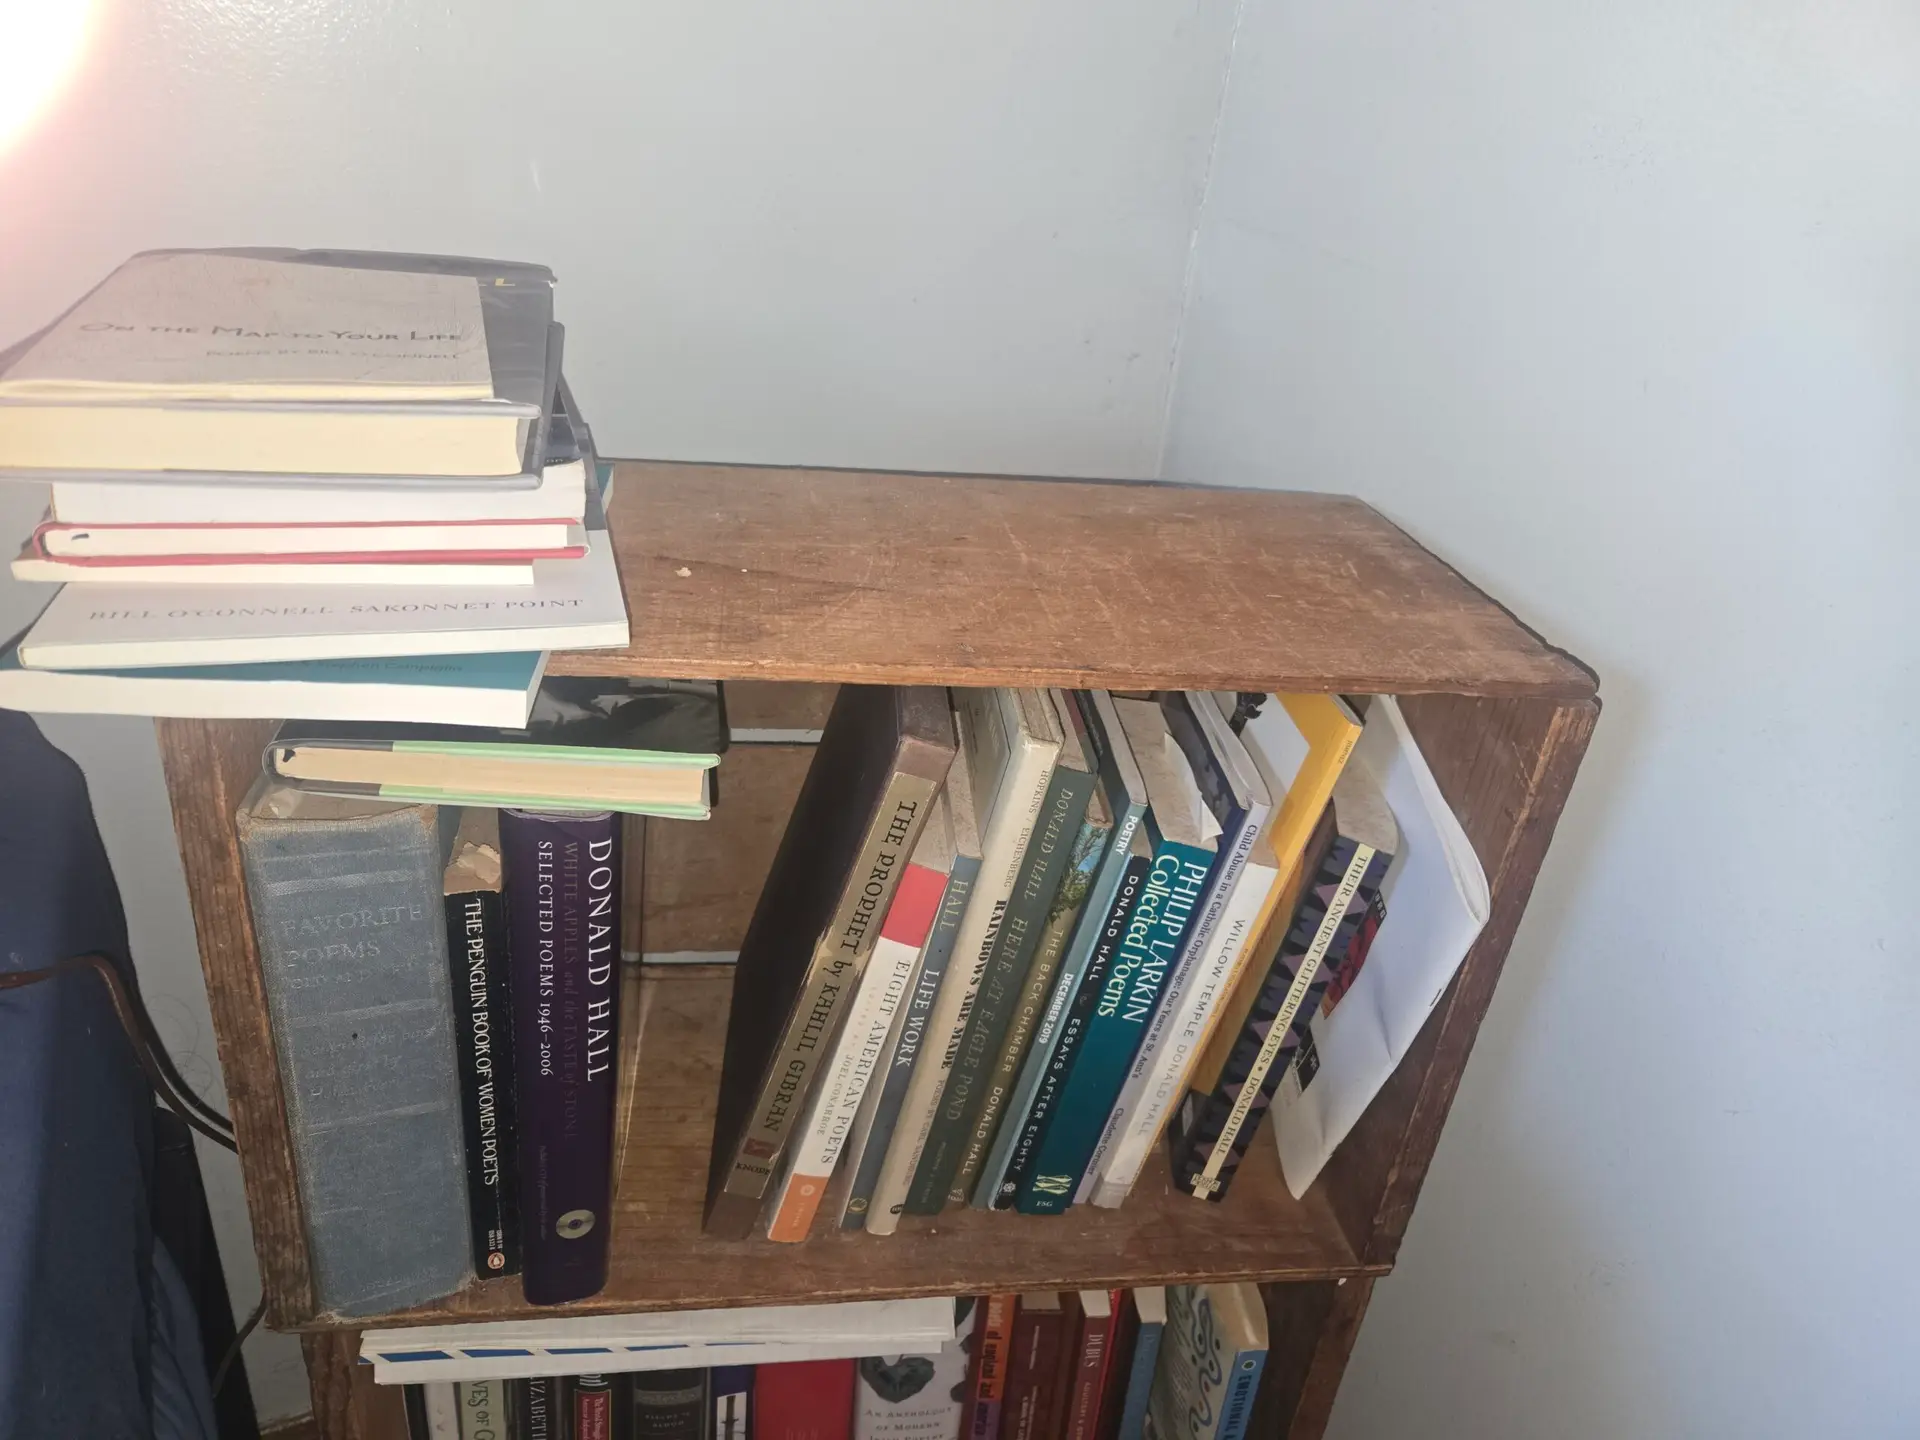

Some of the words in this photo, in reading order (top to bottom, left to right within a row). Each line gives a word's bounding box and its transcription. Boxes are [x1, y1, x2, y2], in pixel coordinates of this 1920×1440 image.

[329, 330, 399, 340] YOUR
[90, 609, 157, 621] BILL
[167, 605, 335, 619] O'CONNELL
[350, 601, 496, 614] SAKONNET
[505, 598, 585, 609] POINT
[1028, 769, 1049, 814] HOPKINS
[881, 800, 918, 847] THE
[1044, 787, 1074, 854] DONALD
[1116, 814, 1140, 856] POETRY
[1238, 823, 1259, 852] Child
[564, 842, 579, 901] WHITE
[1003, 827, 1033, 889] EICHENBERG
[1024, 859, 1049, 901] HALL
[1223, 851, 1244, 881] Abuse
[1339, 854, 1369, 897] THEIR
[538, 840, 554, 933] SELECTED
[840, 850, 897, 955] PROPHET
[939, 878, 969, 932] HALL
[1106, 875, 1140, 938] DONALD
[1124, 854, 1181, 951] Collected
[1160, 861, 1209, 937] PHILIP
[1221, 883, 1232, 893] in
[280, 904, 423, 938] FAVORITE
[466, 898, 484, 936] THE
[563, 904, 579, 965] APPLES
[588, 836, 613, 986] DONALD
[1200, 899, 1222, 938] Catholic
[1311, 899, 1347, 958] ANCIENT
[284, 940, 381, 968] POEMS
[970, 899, 1008, 986] RAINBOWS
[997, 914, 1030, 974] HERE
[1044, 927, 1064, 958] THE
[1088, 944, 1111, 981] HALL
[1172, 937, 1205, 989] Orphanage:
[1207, 918, 1246, 979] WILLOW
[467, 937, 489, 1009] PENGUIN
[539, 939, 554, 996] POEMS
[564, 971, 579, 996] and
[822, 959, 853, 979] by
[878, 959, 911, 1017] EIGHT
[913, 968, 940, 1010] LIFE
[1028, 963, 1051, 1003] BACK
[1096, 952, 1143, 1018] Poems
[1121, 938, 1177, 1024] LARKIN
[957, 990, 977, 1023] ARE
[986, 980, 1005, 1005] AT
[1048, 971, 1075, 1022] DECEMBER
[1165, 989, 1180, 1005] Our
[1183, 983, 1216, 1038] TEMPLE
[1273, 956, 1318, 1033] GLITTERING
[472, 1010, 492, 1057] BOOK
[587, 996, 611, 1082] HALL
[795, 982, 841, 1052] KAHLIL
[966, 1007, 996, 1070] EAGLE
[1002, 1006, 1035, 1073] CHAMBER
[1038, 1021, 1055, 1045] 2019
[1154, 1003, 1172, 1034] Years
[836, 1053, 854, 1076] JOEL
[842, 1019, 887, 1111] AMERICAN
[895, 1015, 926, 1068] WORK
[940, 1026, 964, 1071] MADE
[1054, 1018, 1082, 1071] ESSAYS
[1260, 1033, 1281, 1065] EYES
[475, 1055, 493, 1080] OF
[1131, 1055, 1149, 1079] Ann's
[1155, 1043, 1188, 1106] DONALD
[477, 1079, 497, 1138] WOMEN
[763, 1058, 807, 1133] GIBRAN
[946, 1073, 974, 1121] POND
[975, 1085, 1004, 1140] DONALD
[1034, 1075, 1057, 1120] AFTER
[1138, 1102, 1162, 1137] HALL
[1230, 1076, 1261, 1127] DONALD
[481, 1138, 500, 1186] POETS
[820, 1115, 851, 1164] POETS
[961, 1143, 983, 1176] HALL
[1013, 1125, 1038, 1172] EIGHTY
[1215, 1125, 1237, 1156] HALL
[1035, 1199, 1054, 1208] FSG
[1084, 1333, 1104, 1368] DUBUS
[475, 1410, 490, 1427] OF
[1222, 1374, 1253, 1432] EMOTIONAL
